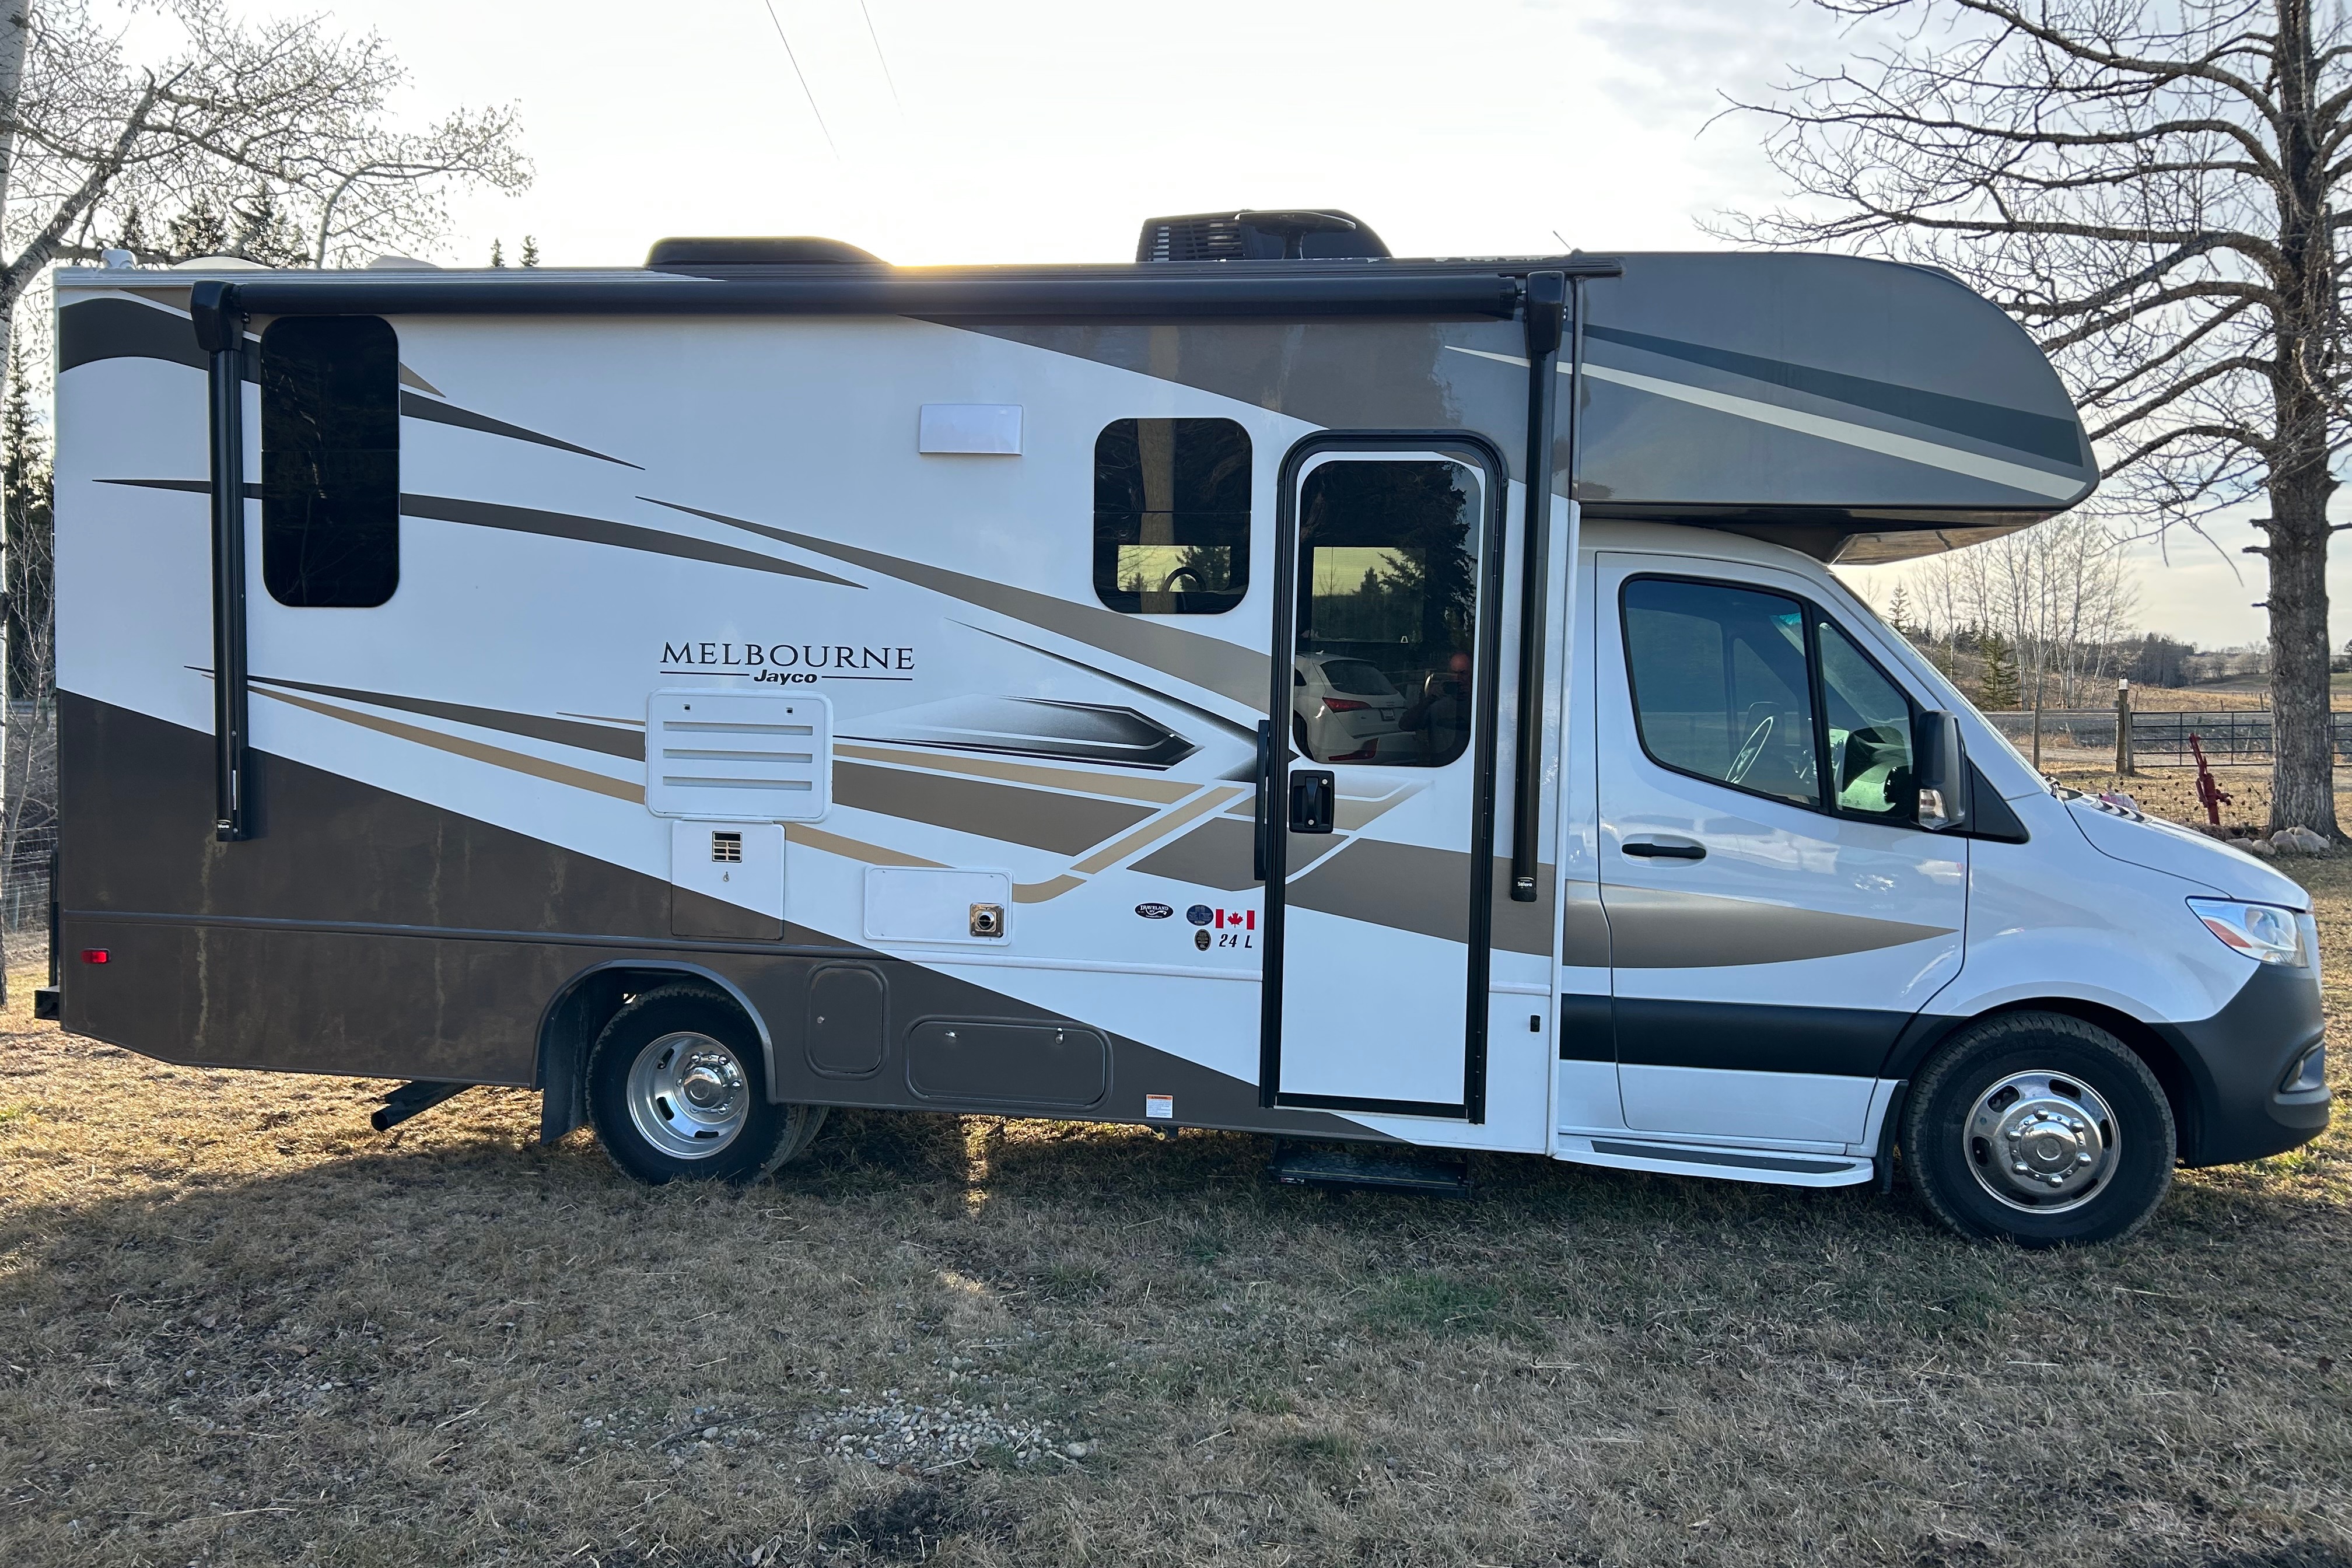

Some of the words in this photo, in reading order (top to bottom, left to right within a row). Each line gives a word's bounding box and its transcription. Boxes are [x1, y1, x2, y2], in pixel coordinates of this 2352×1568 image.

[660, 642, 915, 670] MELBOURNE
[754, 669, 817, 685] Jayco
[1219, 933, 1238, 947] 24
[1244, 935, 1252, 948] L
